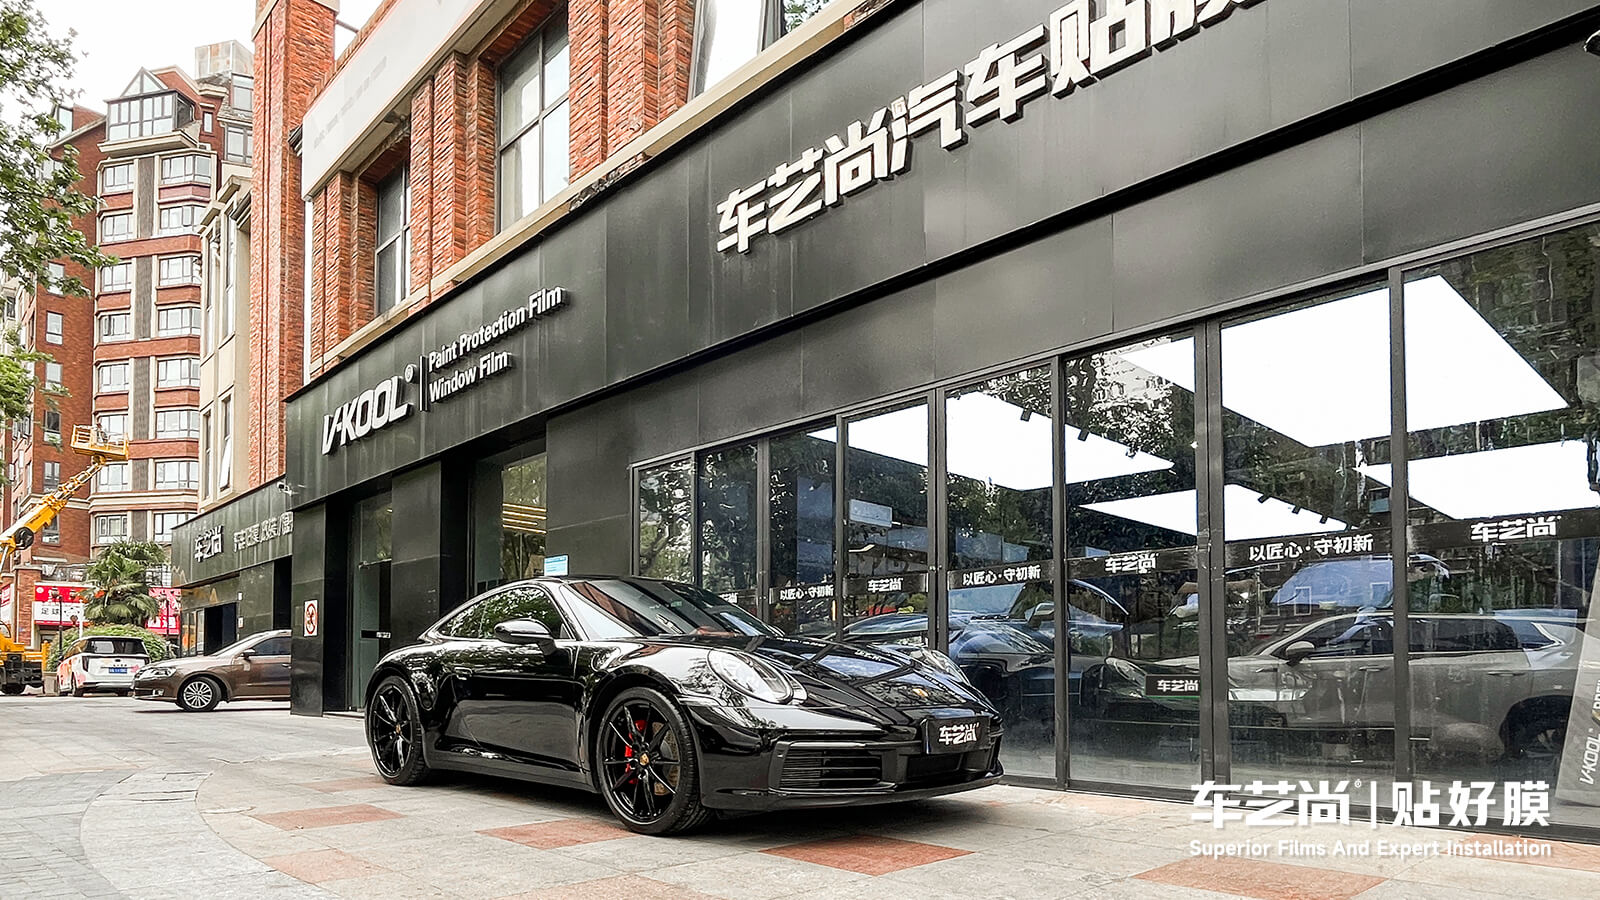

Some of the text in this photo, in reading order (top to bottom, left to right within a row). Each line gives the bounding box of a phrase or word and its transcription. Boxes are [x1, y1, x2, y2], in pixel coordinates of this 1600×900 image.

[428, 286, 562, 373] Paint Protection Film
[429, 351, 508, 402] Window Film
[322, 375, 409, 455] V-KOOL
[1470, 516, 1558, 542] 车艺尚
[194, 525, 223, 562] 车艺尚
[1104, 553, 1157, 574] 车艺尚
[867, 577, 903, 592] 车艺尚
[1157, 680, 1199, 693] 车艺尚
[938, 722, 978, 745] 车艺尚
